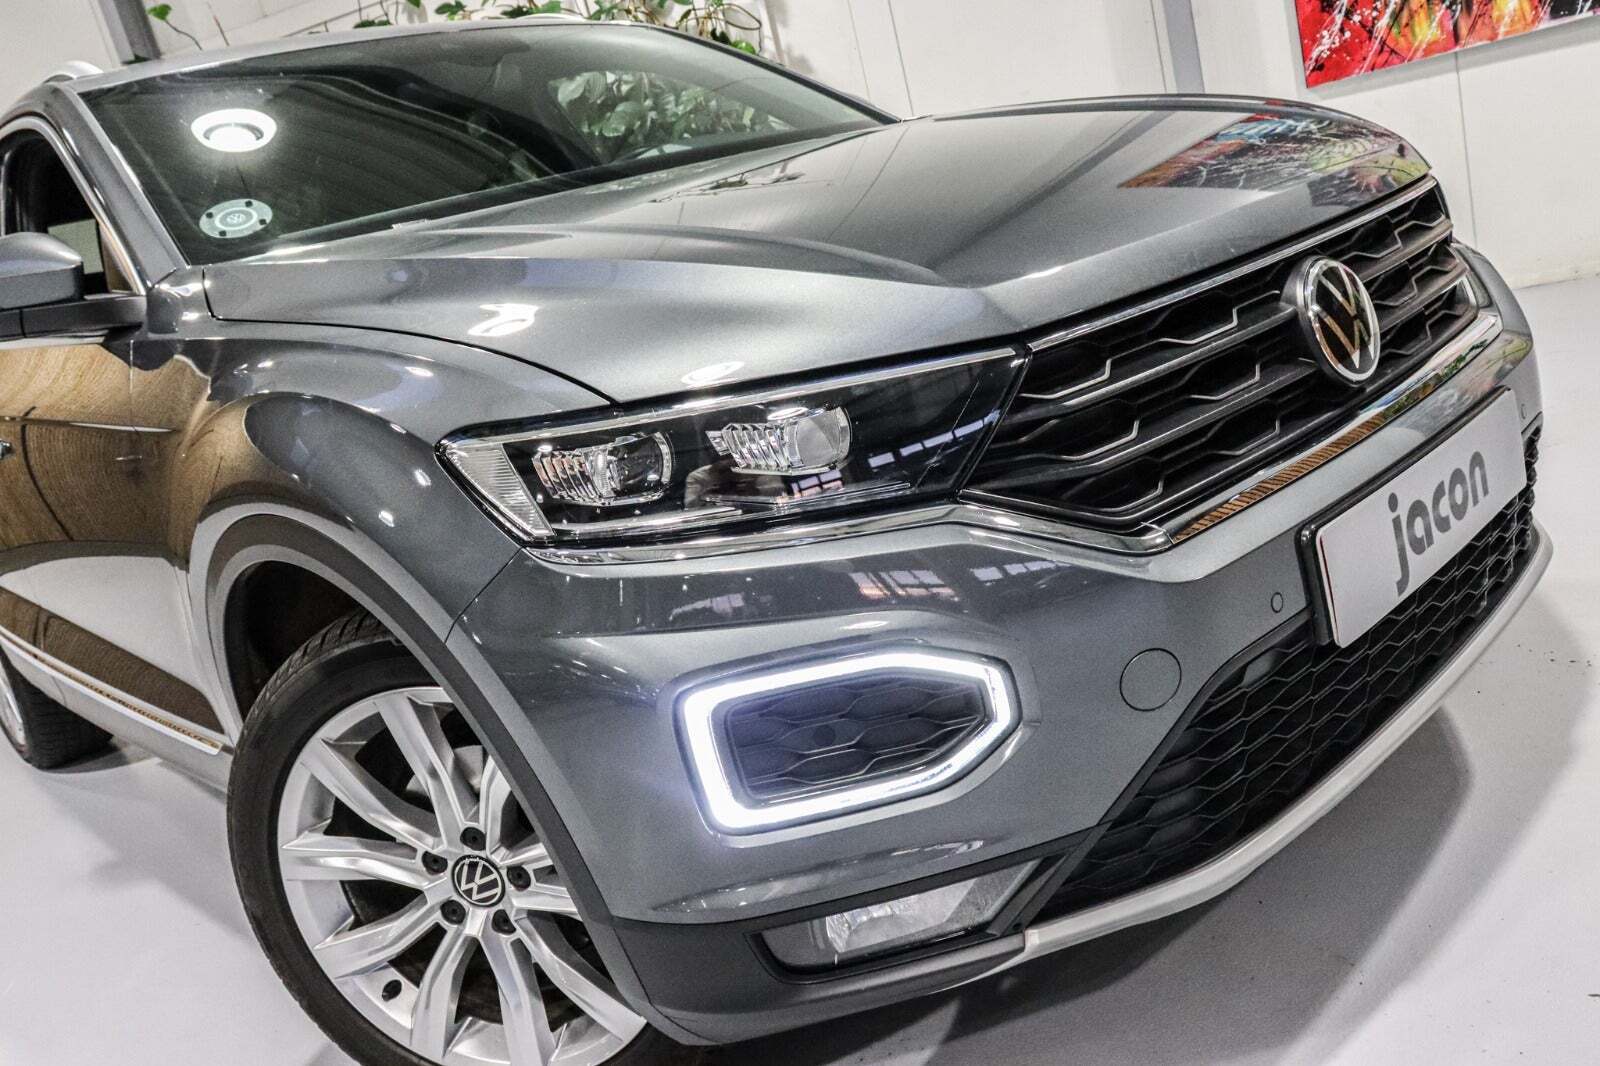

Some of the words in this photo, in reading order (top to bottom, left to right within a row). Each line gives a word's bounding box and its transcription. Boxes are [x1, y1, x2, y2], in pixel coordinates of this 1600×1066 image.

[1311, 260, 1379, 378] VW
[1388, 451, 1489, 597] jacon
[457, 858, 502, 903] VW
